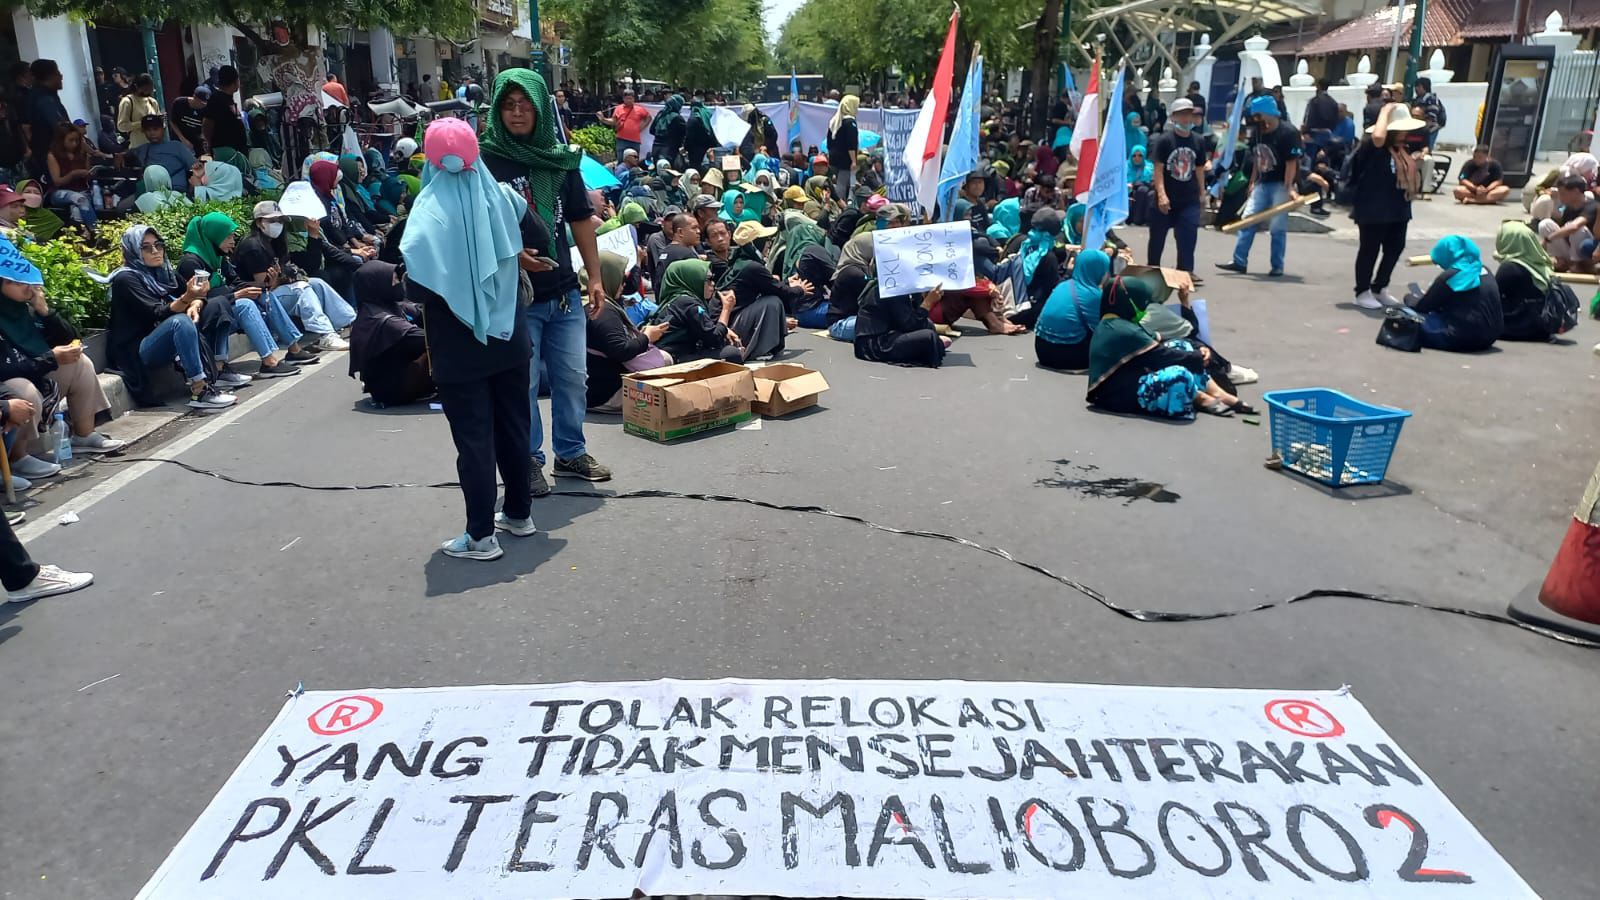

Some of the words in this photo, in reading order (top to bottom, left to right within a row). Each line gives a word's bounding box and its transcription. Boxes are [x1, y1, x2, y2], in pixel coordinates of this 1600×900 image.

[881, 253, 900, 290] PKL
[914, 231, 934, 276] WONG
[529, 696, 735, 734] TOLAK
[765, 695, 1046, 733] RELOKASI
[271, 736, 488, 787] YANG
[519, 734, 704, 778] TIDAK
[720, 733, 1423, 787] MENSEJAHTERAKAN
[200, 797, 396, 882] PKL
[443, 790, 748, 872] TERAS
[781, 790, 1370, 884] MALIOBORO
[1363, 803, 1475, 885] 2
